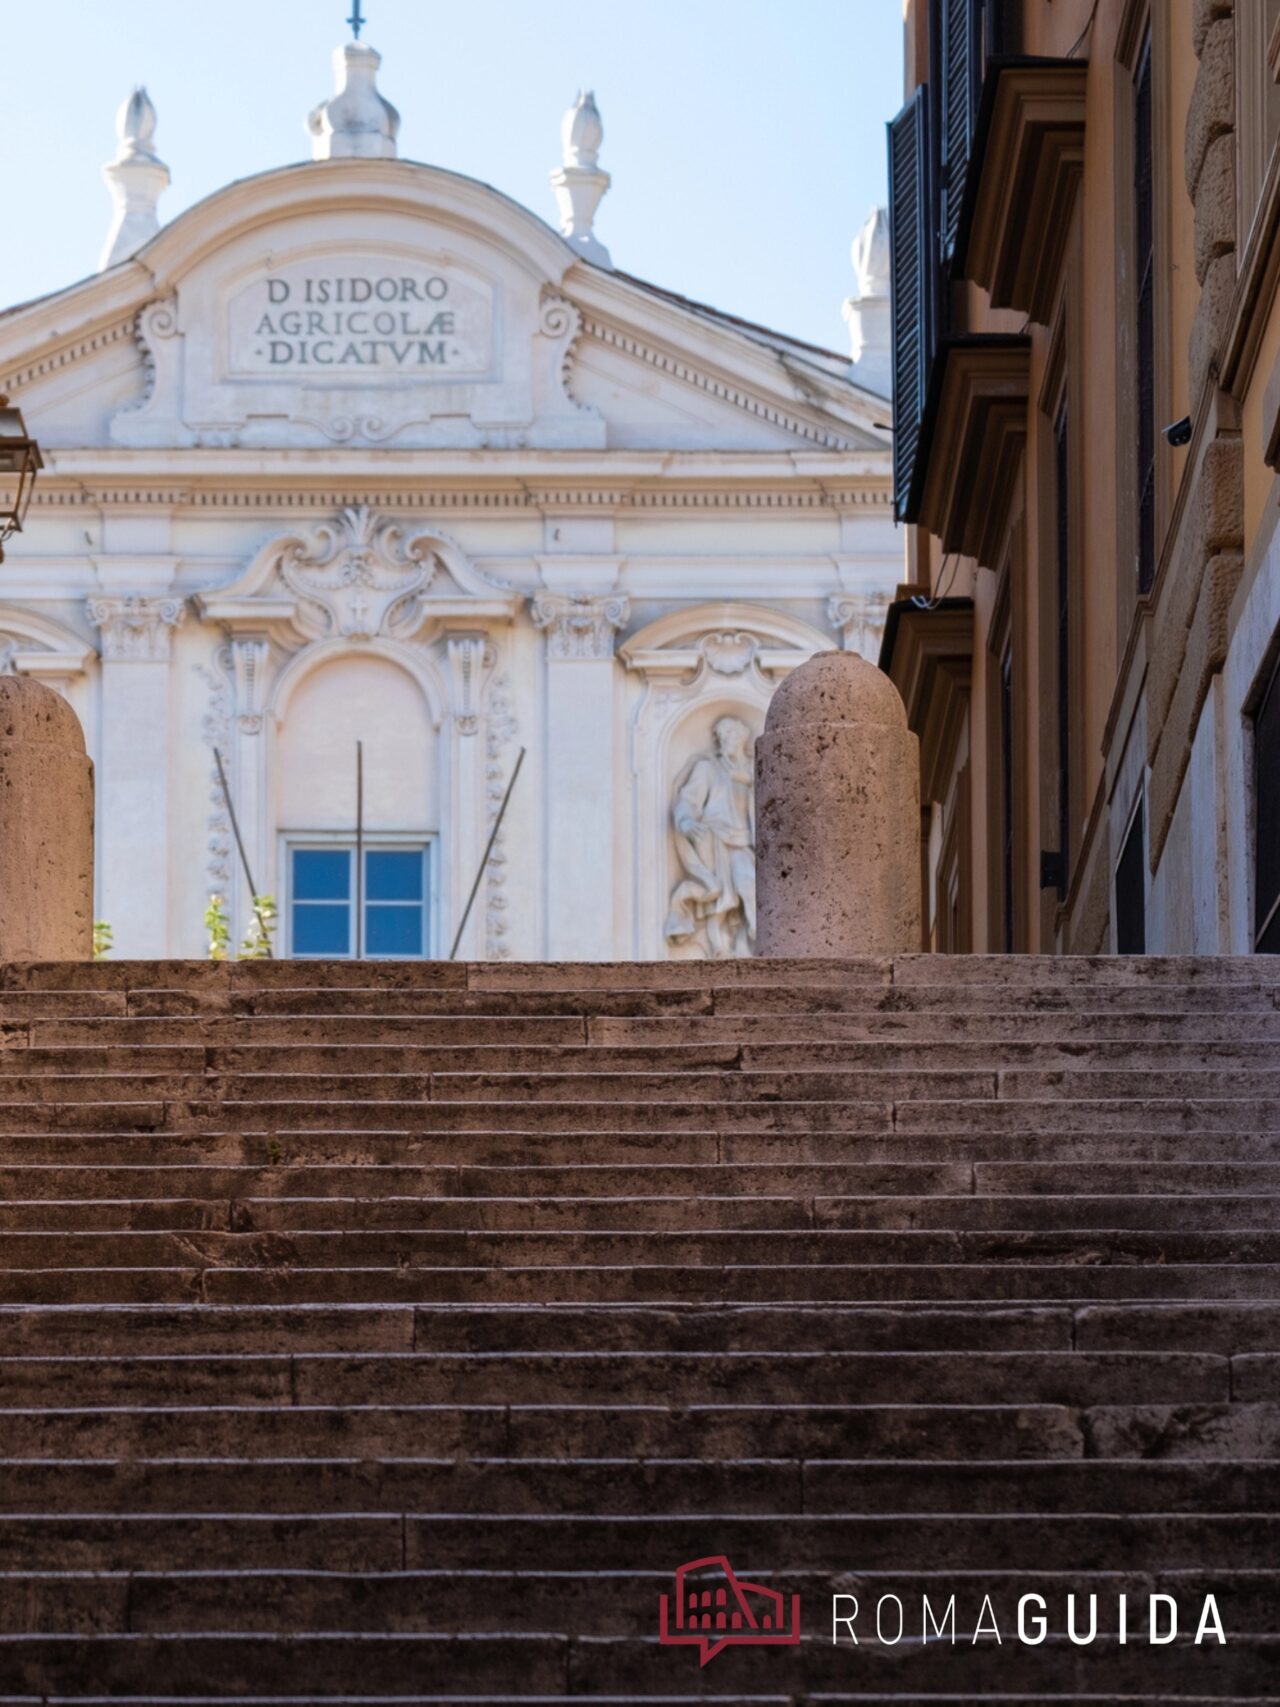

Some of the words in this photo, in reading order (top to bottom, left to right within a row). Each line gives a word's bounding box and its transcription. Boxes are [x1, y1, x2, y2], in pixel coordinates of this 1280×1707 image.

[266, 279, 290, 304] D
[304, 277, 449, 304] ISIDORO
[255, 311, 455, 335] AGRICOLÆ
